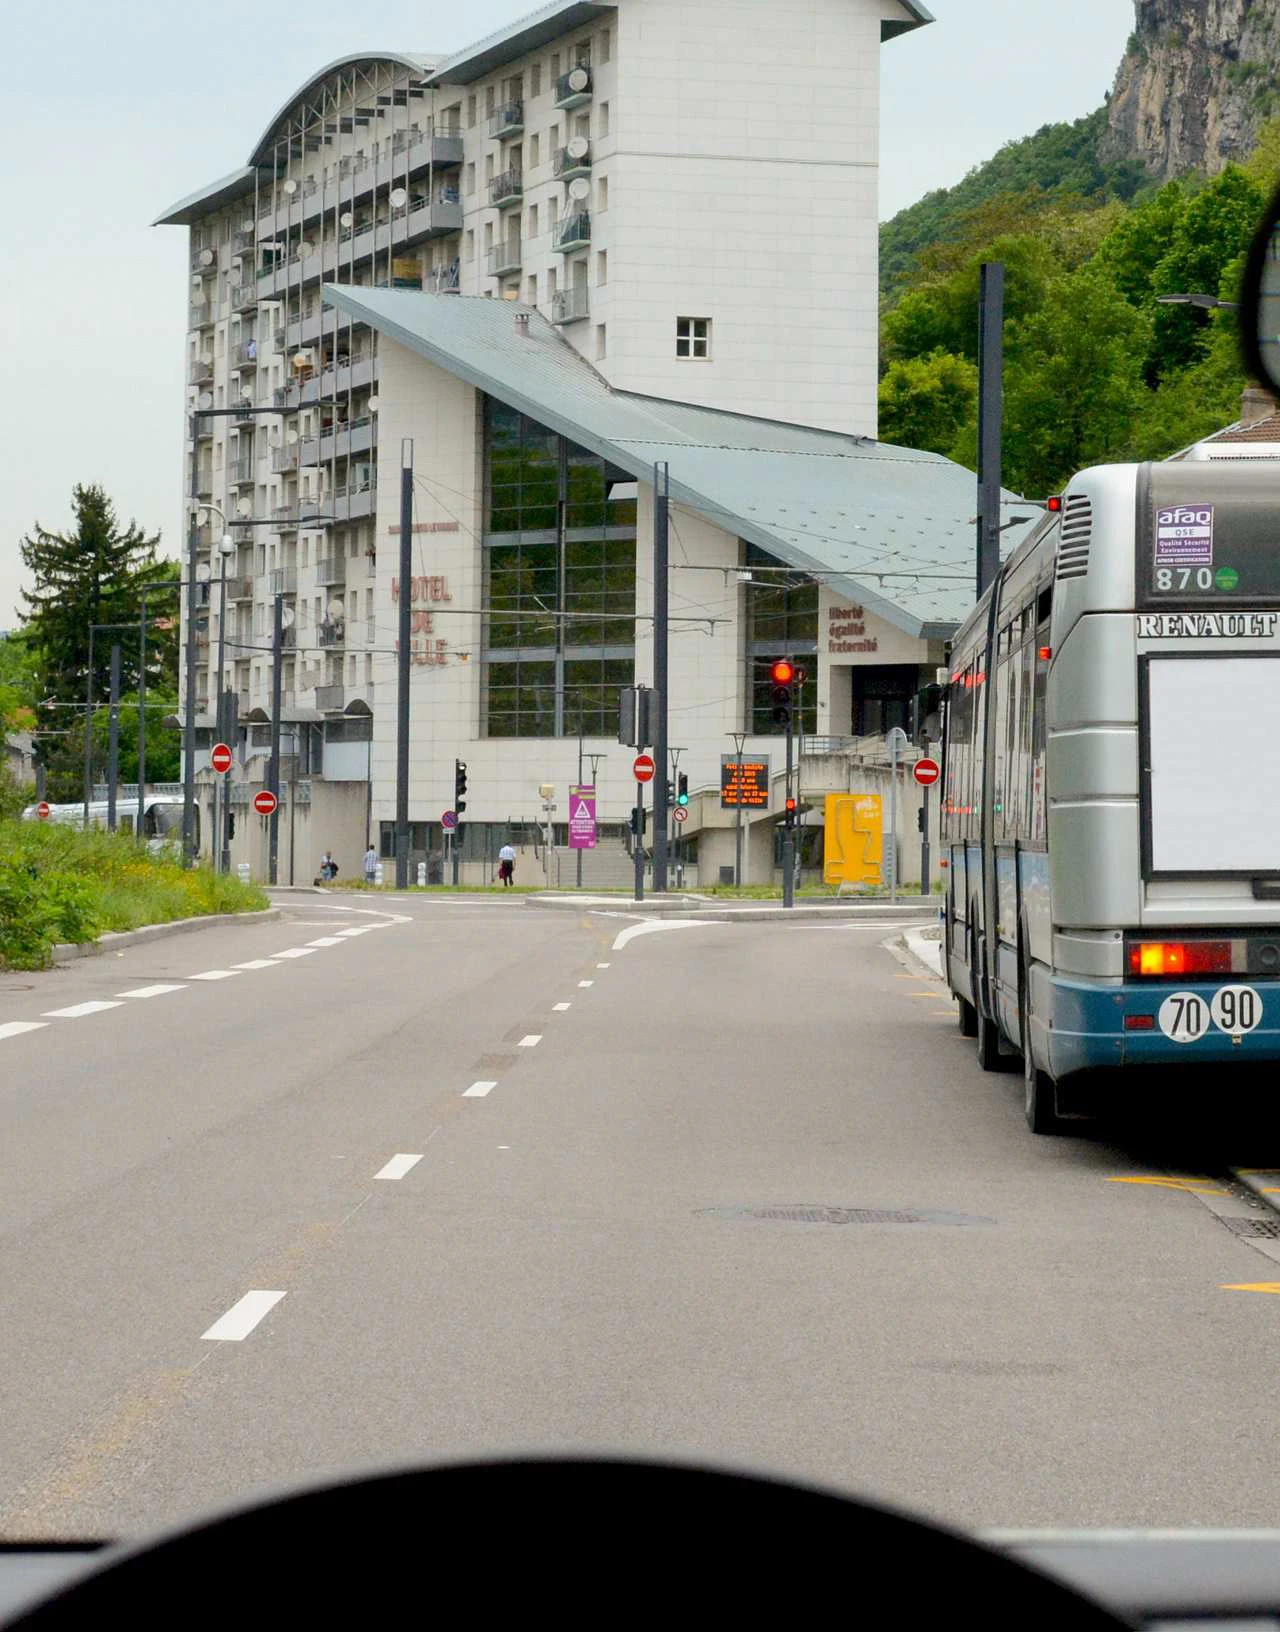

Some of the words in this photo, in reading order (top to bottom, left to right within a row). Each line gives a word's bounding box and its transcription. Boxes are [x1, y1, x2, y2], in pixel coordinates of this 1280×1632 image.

[1174, 528, 1196, 537] QSE
[1157, 567, 1212, 590] 870
[1138, 614, 1277, 638] RENAULT
[1169, 998, 1201, 1037] 70
[1221, 990, 1254, 1030] 90
